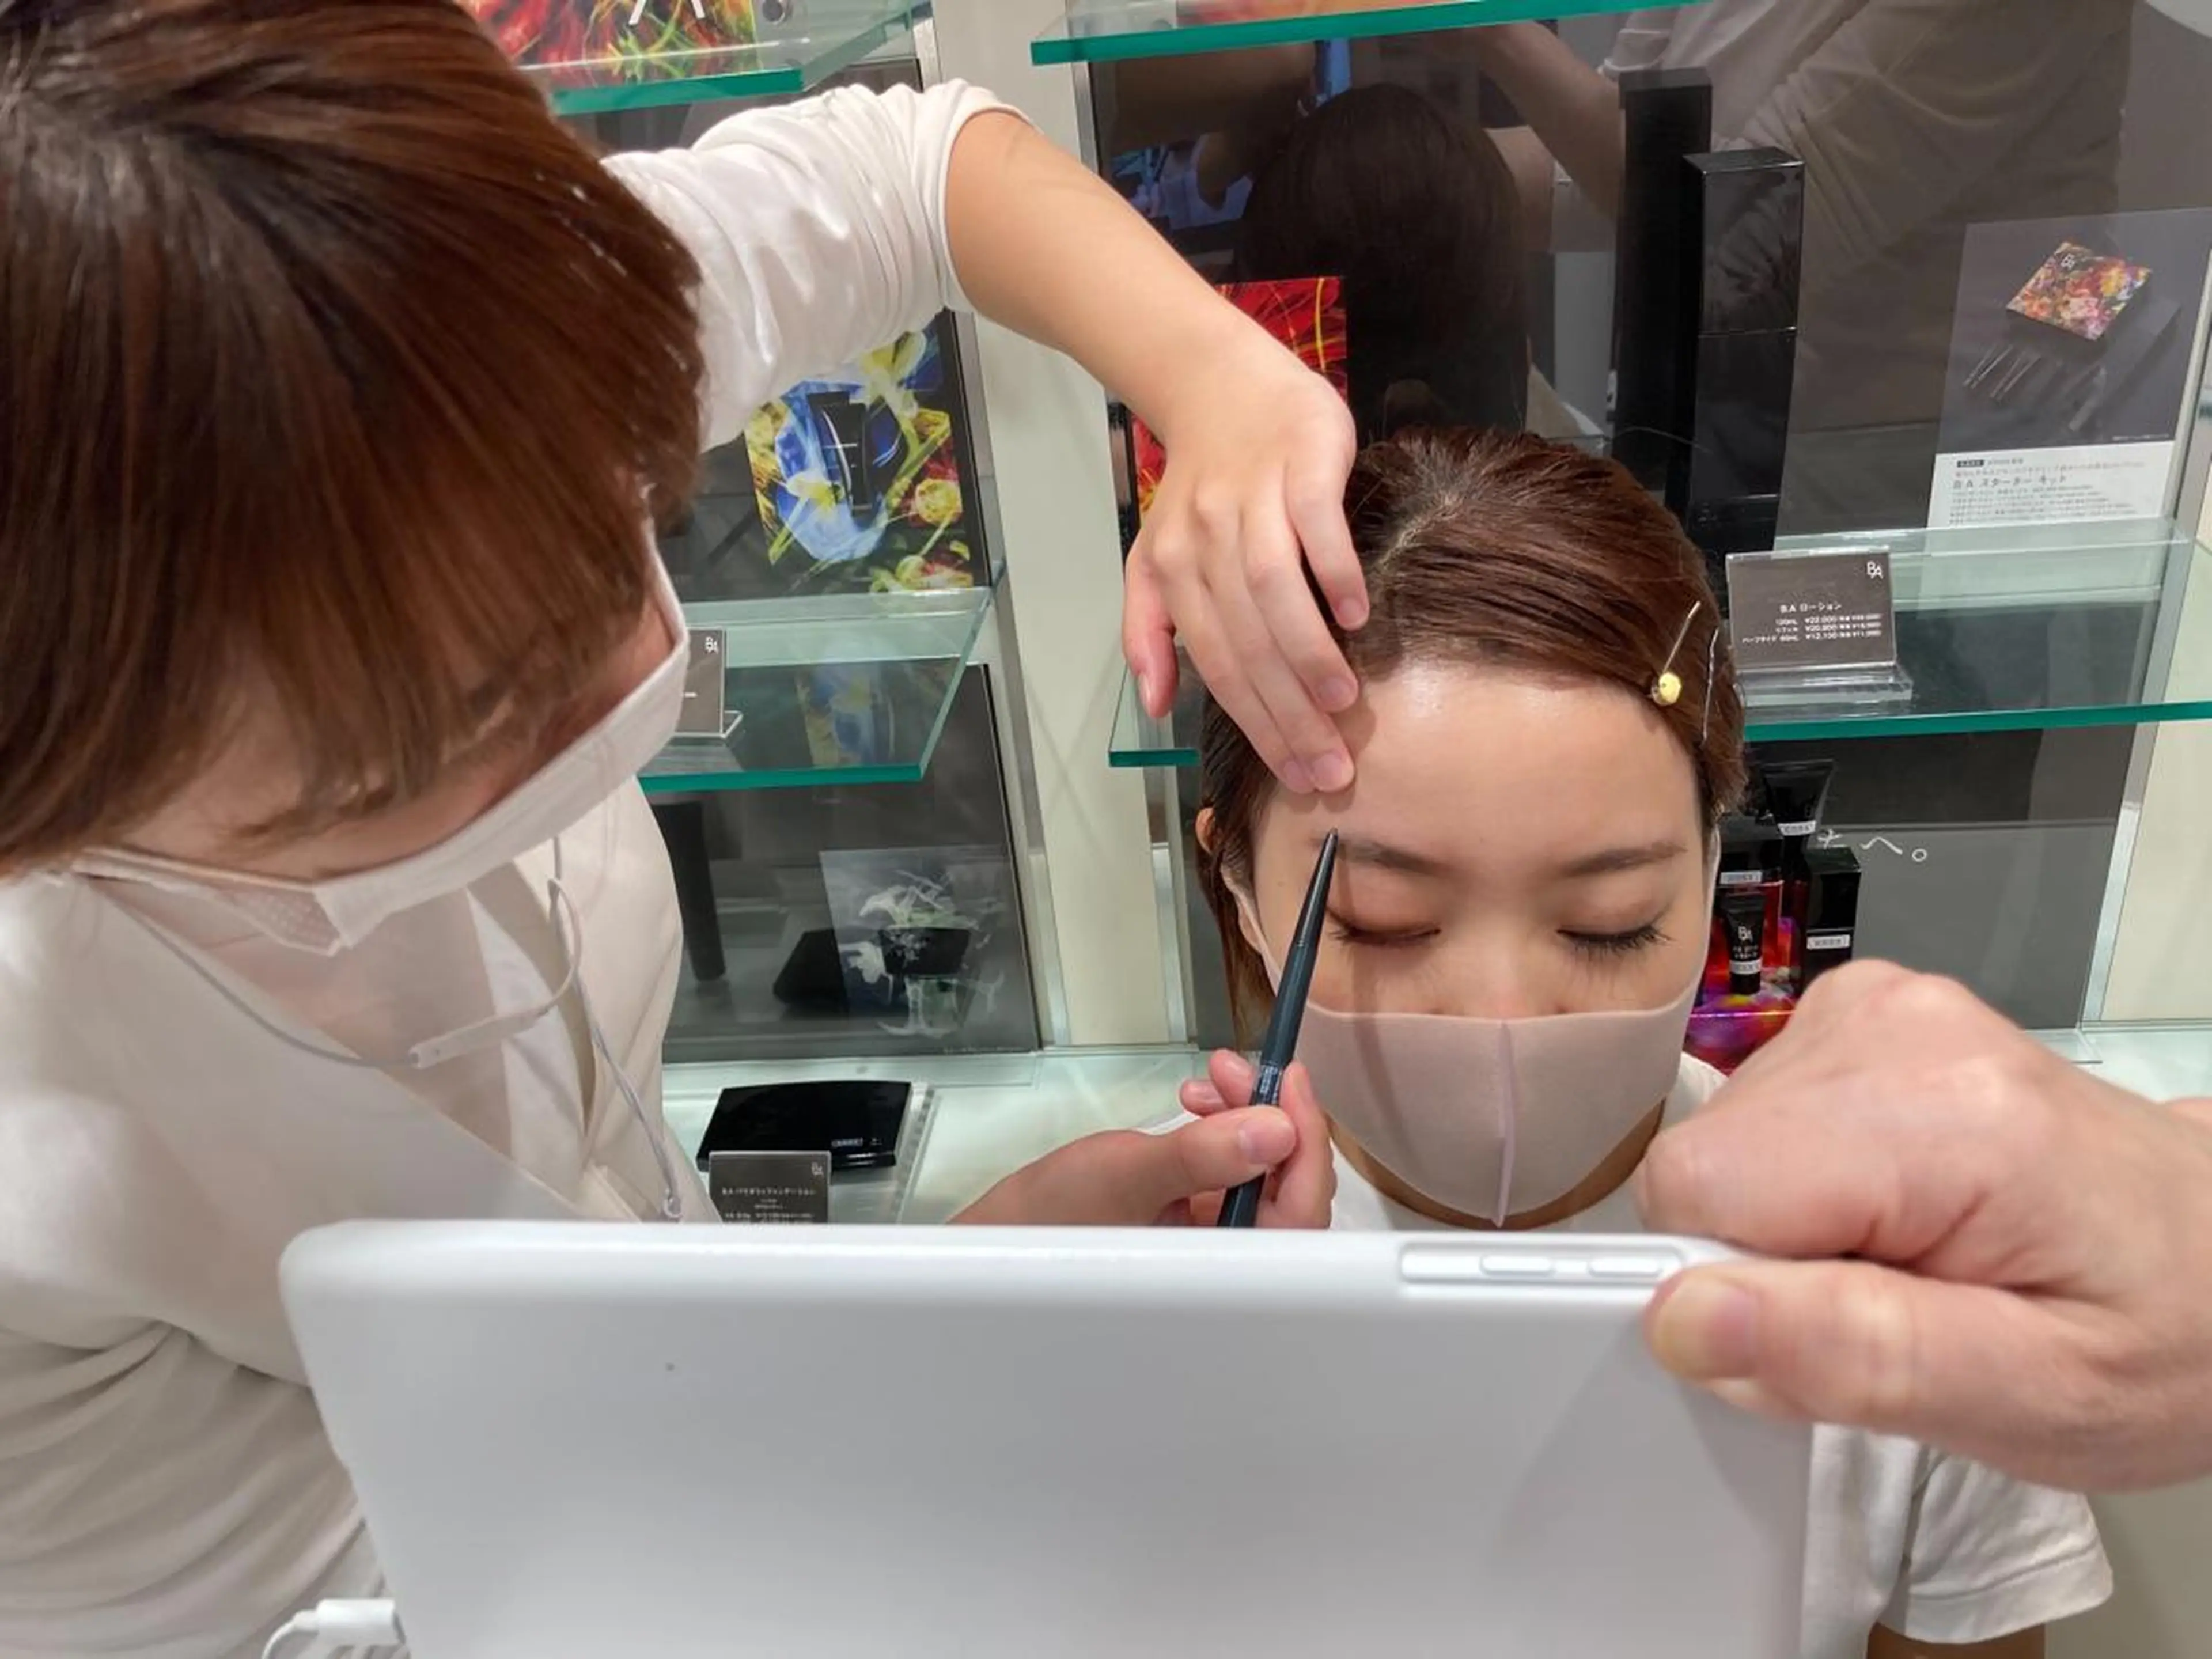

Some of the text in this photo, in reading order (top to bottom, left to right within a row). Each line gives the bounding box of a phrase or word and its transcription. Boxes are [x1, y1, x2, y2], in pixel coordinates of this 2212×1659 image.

[1866, 560, 1883, 579] BA
[1800, 601, 1842, 612] ローション
